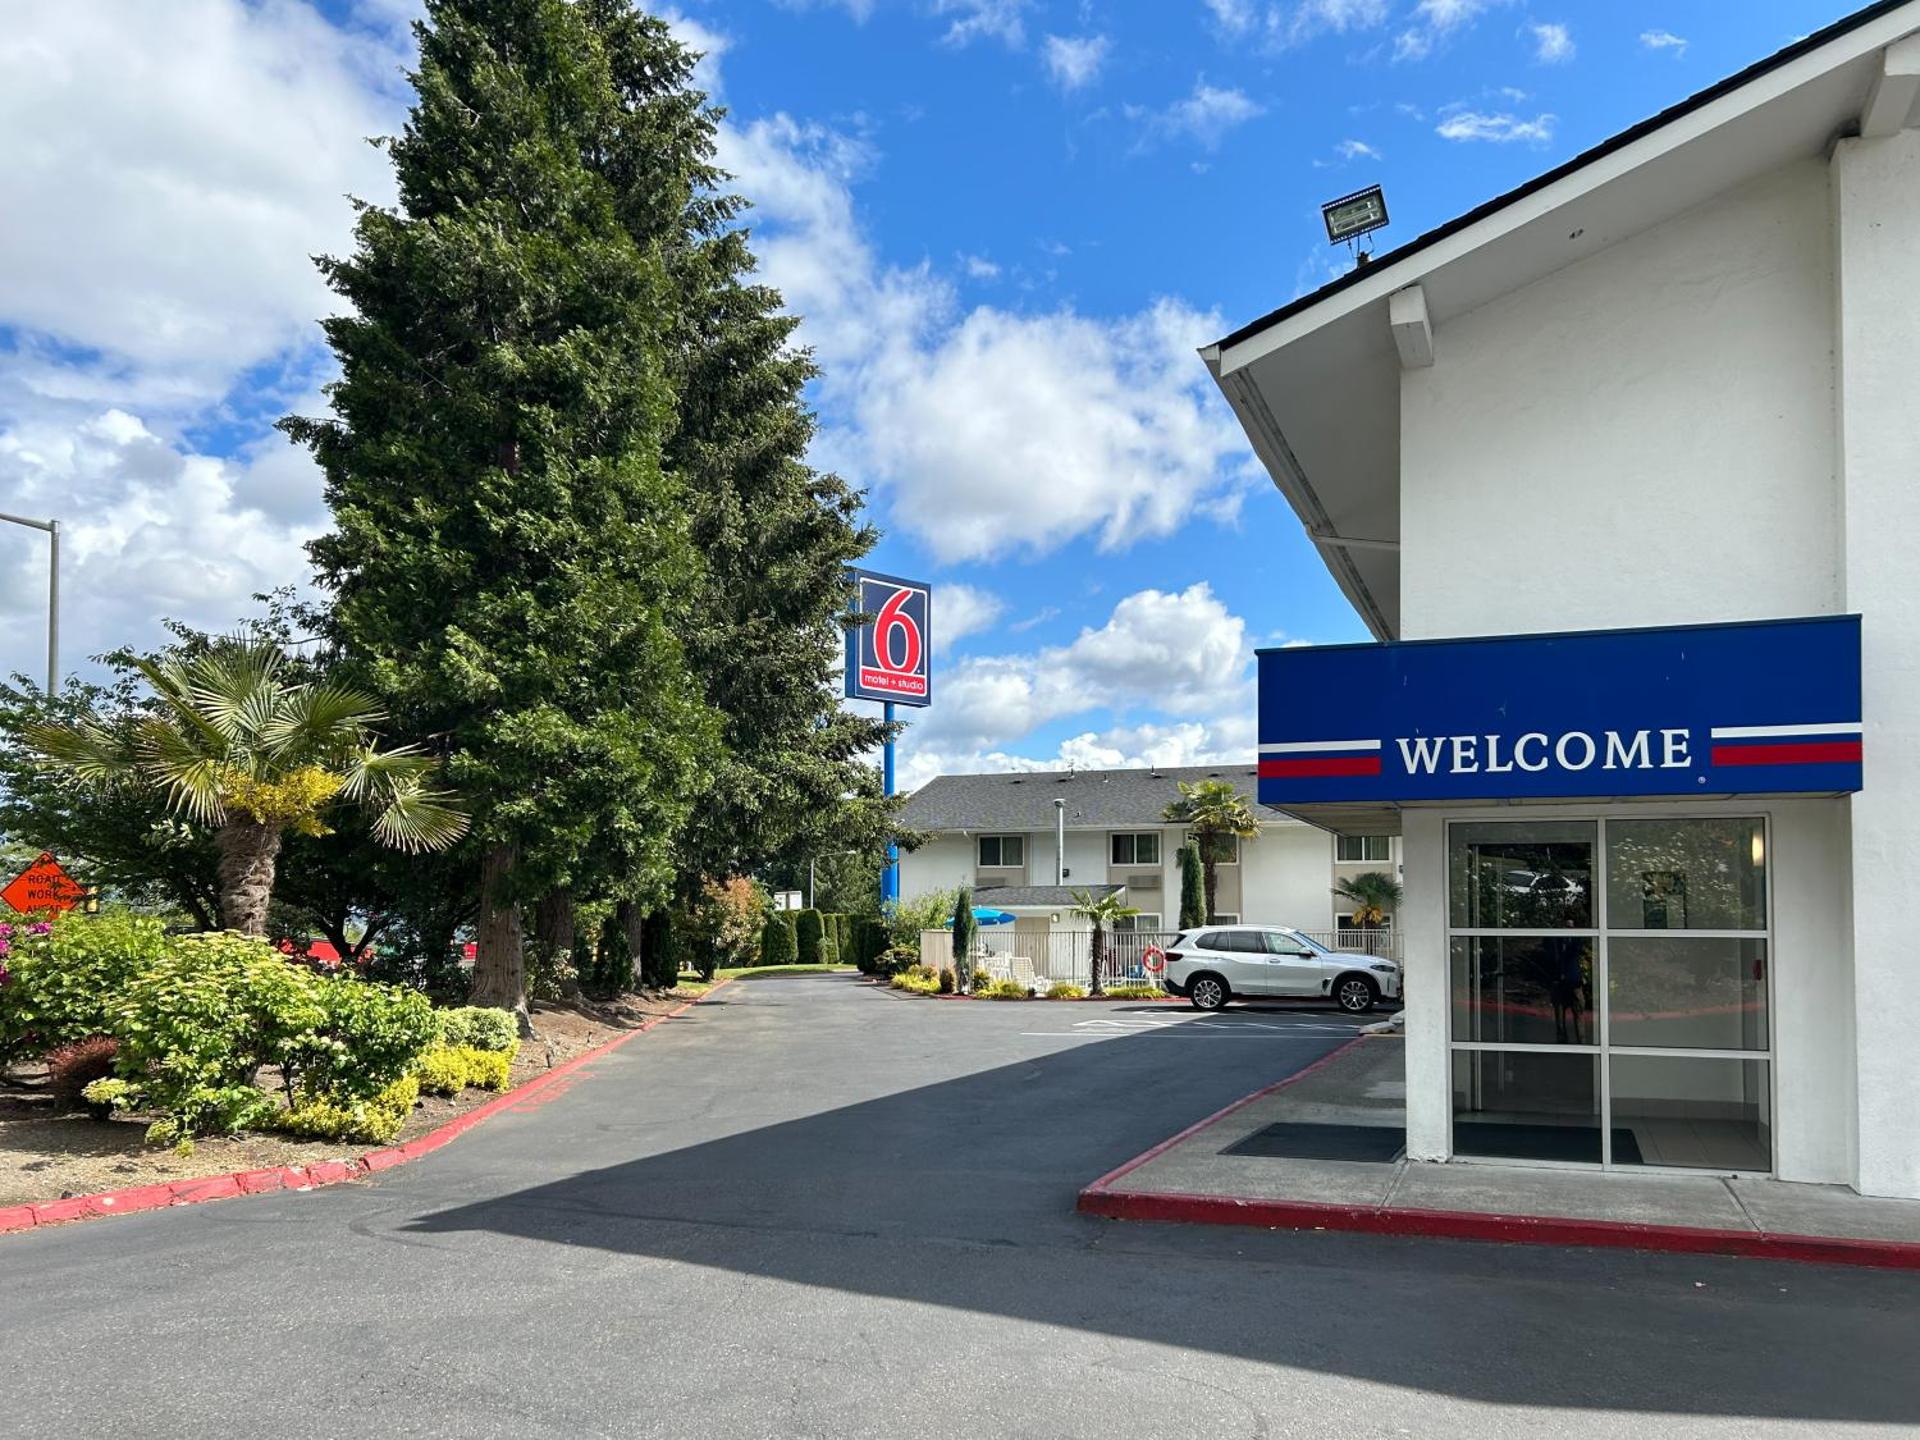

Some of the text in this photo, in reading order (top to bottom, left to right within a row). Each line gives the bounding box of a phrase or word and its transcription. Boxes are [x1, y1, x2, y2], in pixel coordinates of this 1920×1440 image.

[873, 588, 921, 675] 6
[864, 675, 889, 686] motel
[898, 679, 924, 690] studio
[1395, 728, 1692, 774] WELCOME
[28, 874, 60, 884] ROAD
[28, 889, 59, 900] WORK
